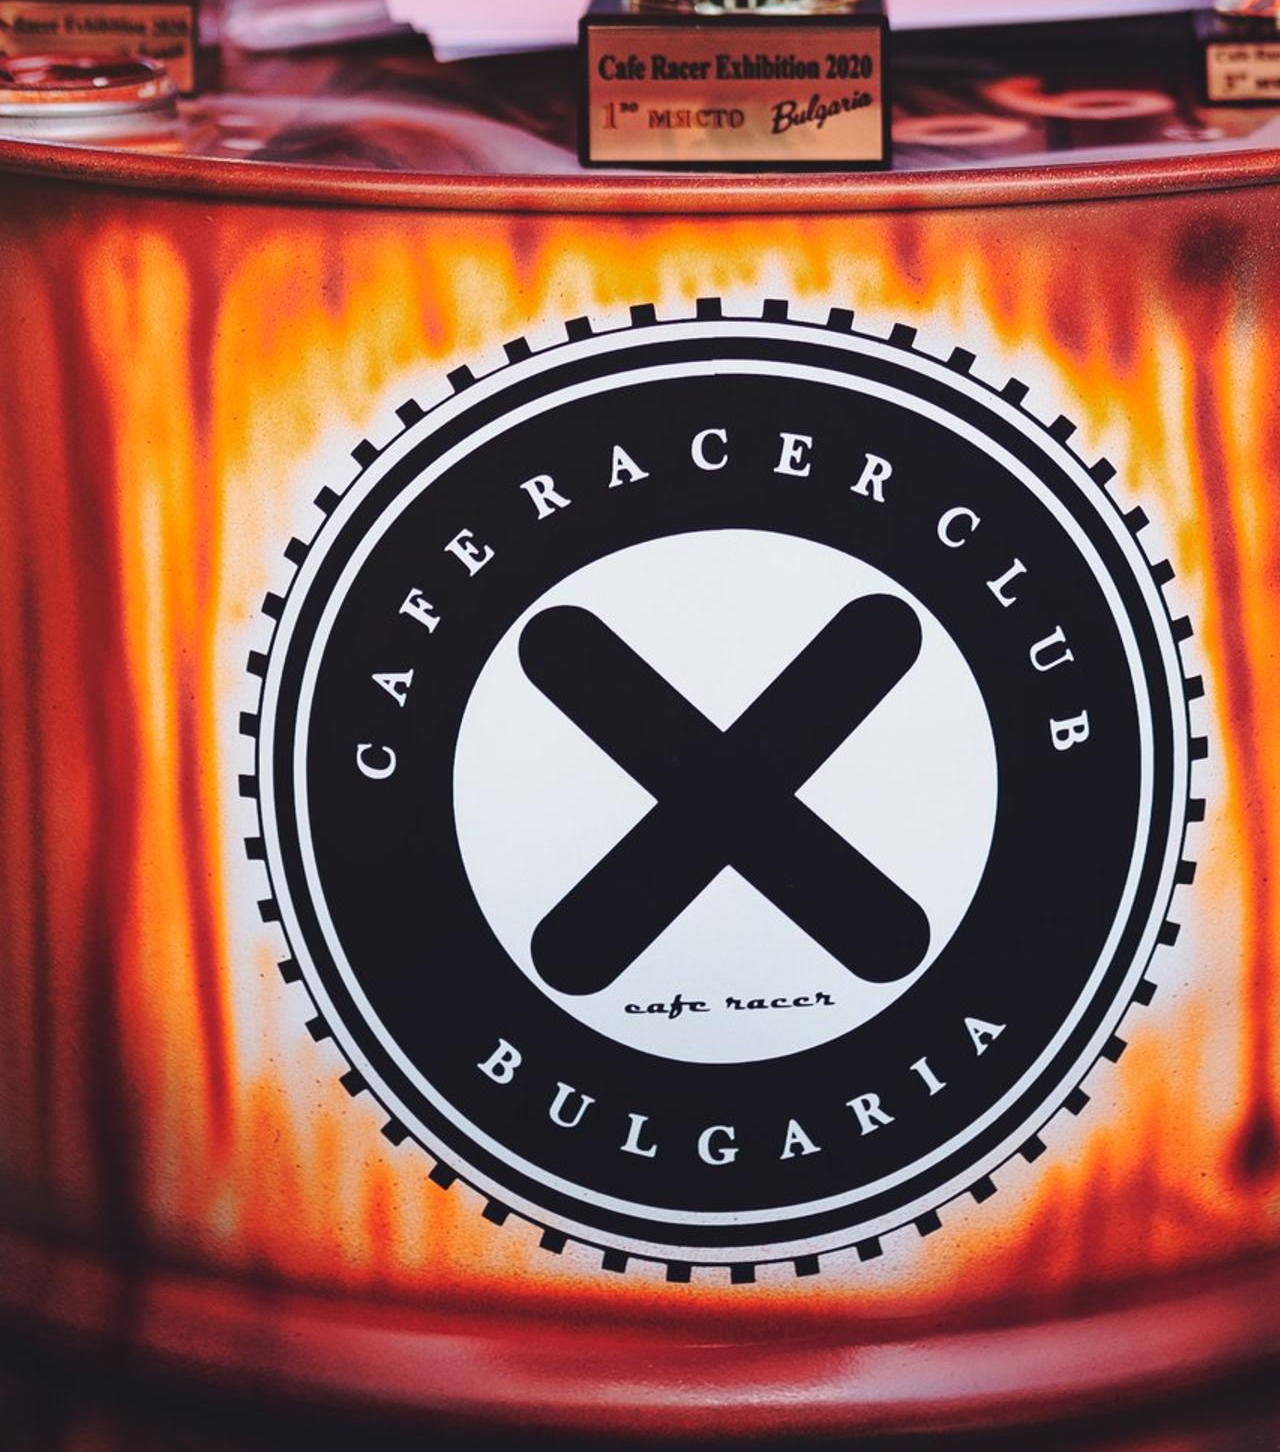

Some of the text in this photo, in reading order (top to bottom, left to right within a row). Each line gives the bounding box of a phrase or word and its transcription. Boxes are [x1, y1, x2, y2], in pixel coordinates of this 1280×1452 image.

[598, 53, 873, 81] Cafe Racer Exhibition 2020
[770, 90, 874, 135] Bulgaria
[355, 427, 1091, 781] CAFE RACER CLUB
[624, 991, 836, 1019] cafe racer
[476, 1016, 1008, 1166] BULGARIA
